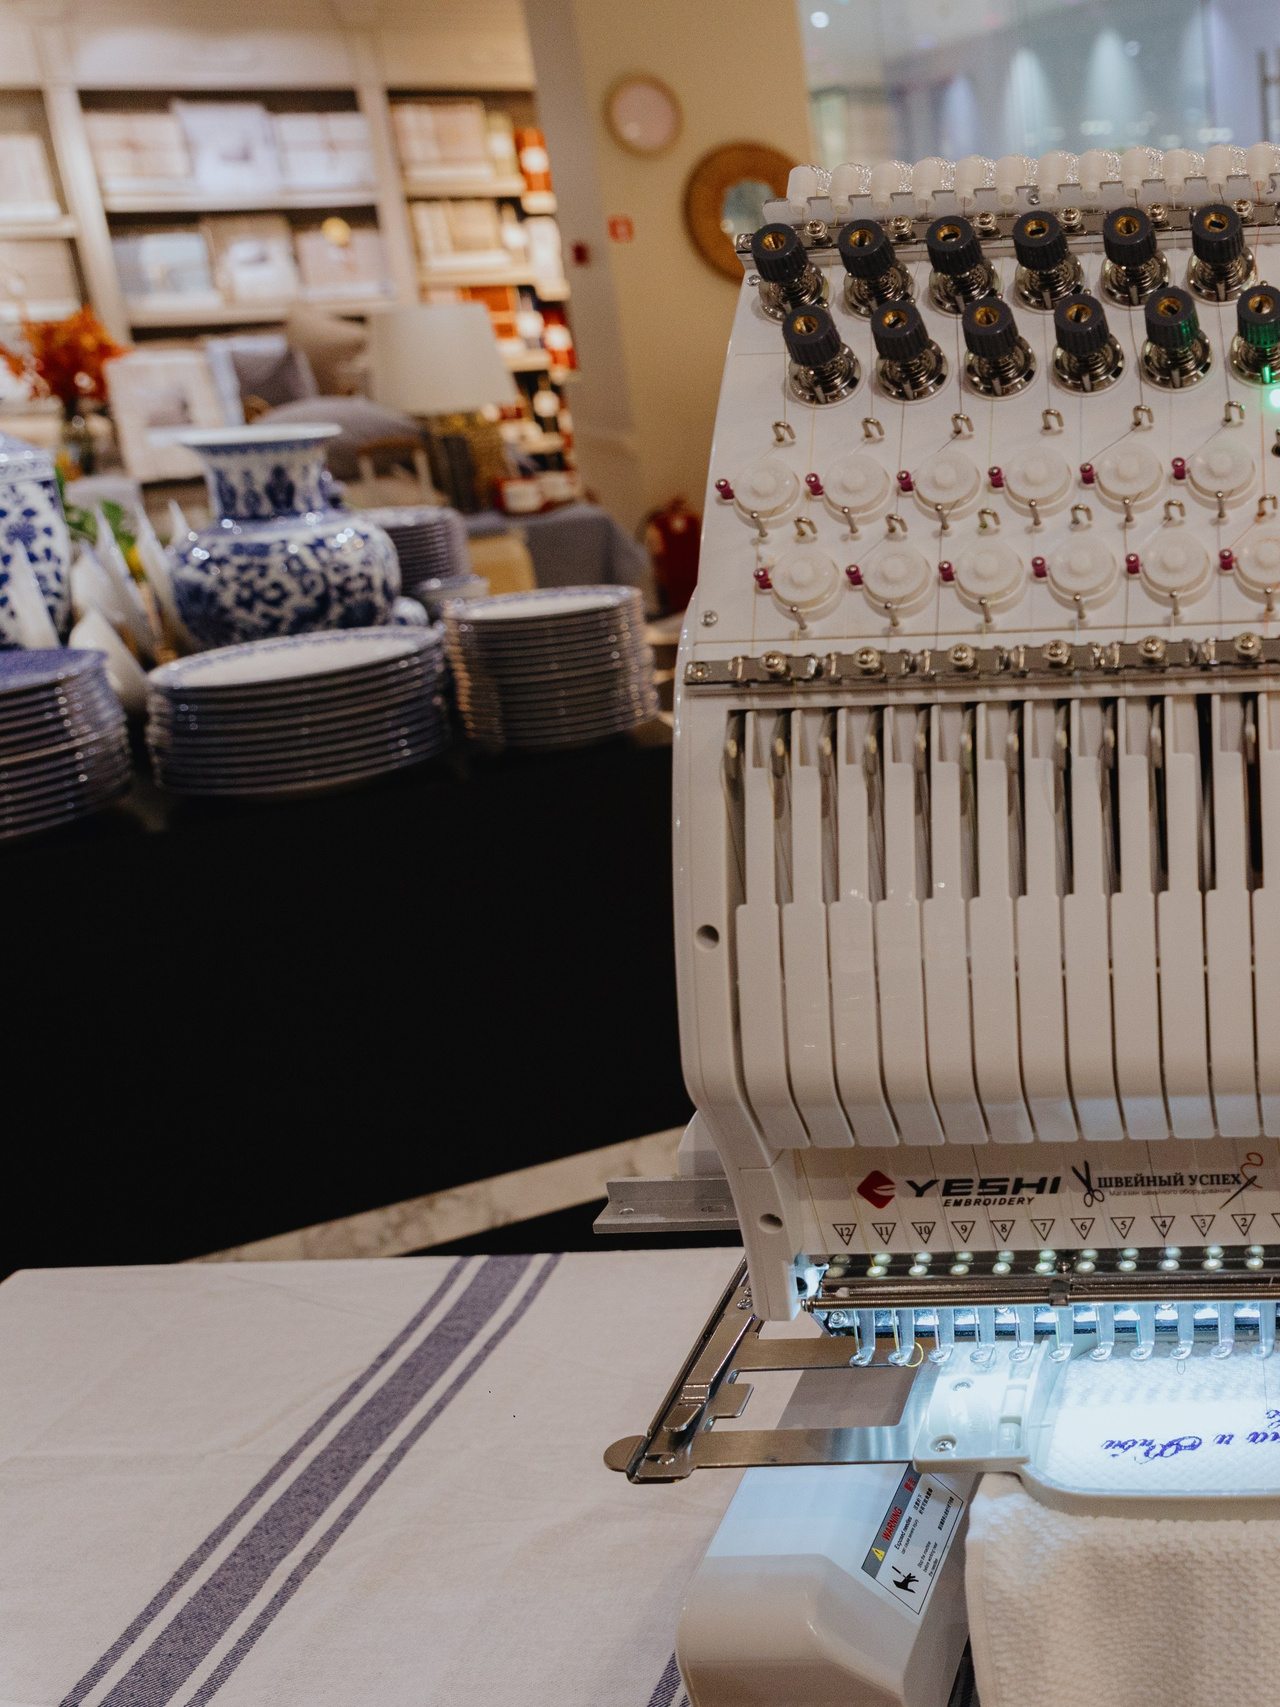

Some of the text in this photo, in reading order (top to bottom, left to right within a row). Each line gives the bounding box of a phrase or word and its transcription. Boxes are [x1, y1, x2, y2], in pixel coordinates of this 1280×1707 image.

[906, 1176, 1062, 1197] YESHI
[1098, 1172, 1242, 1188] ШВЕЙНЫЙ УСПЕХ
[943, 1197, 1035, 1207] EMBROIDERY
[882, 1506, 902, 1541] WARNING
[894, 1531, 906, 1550] Exposed
